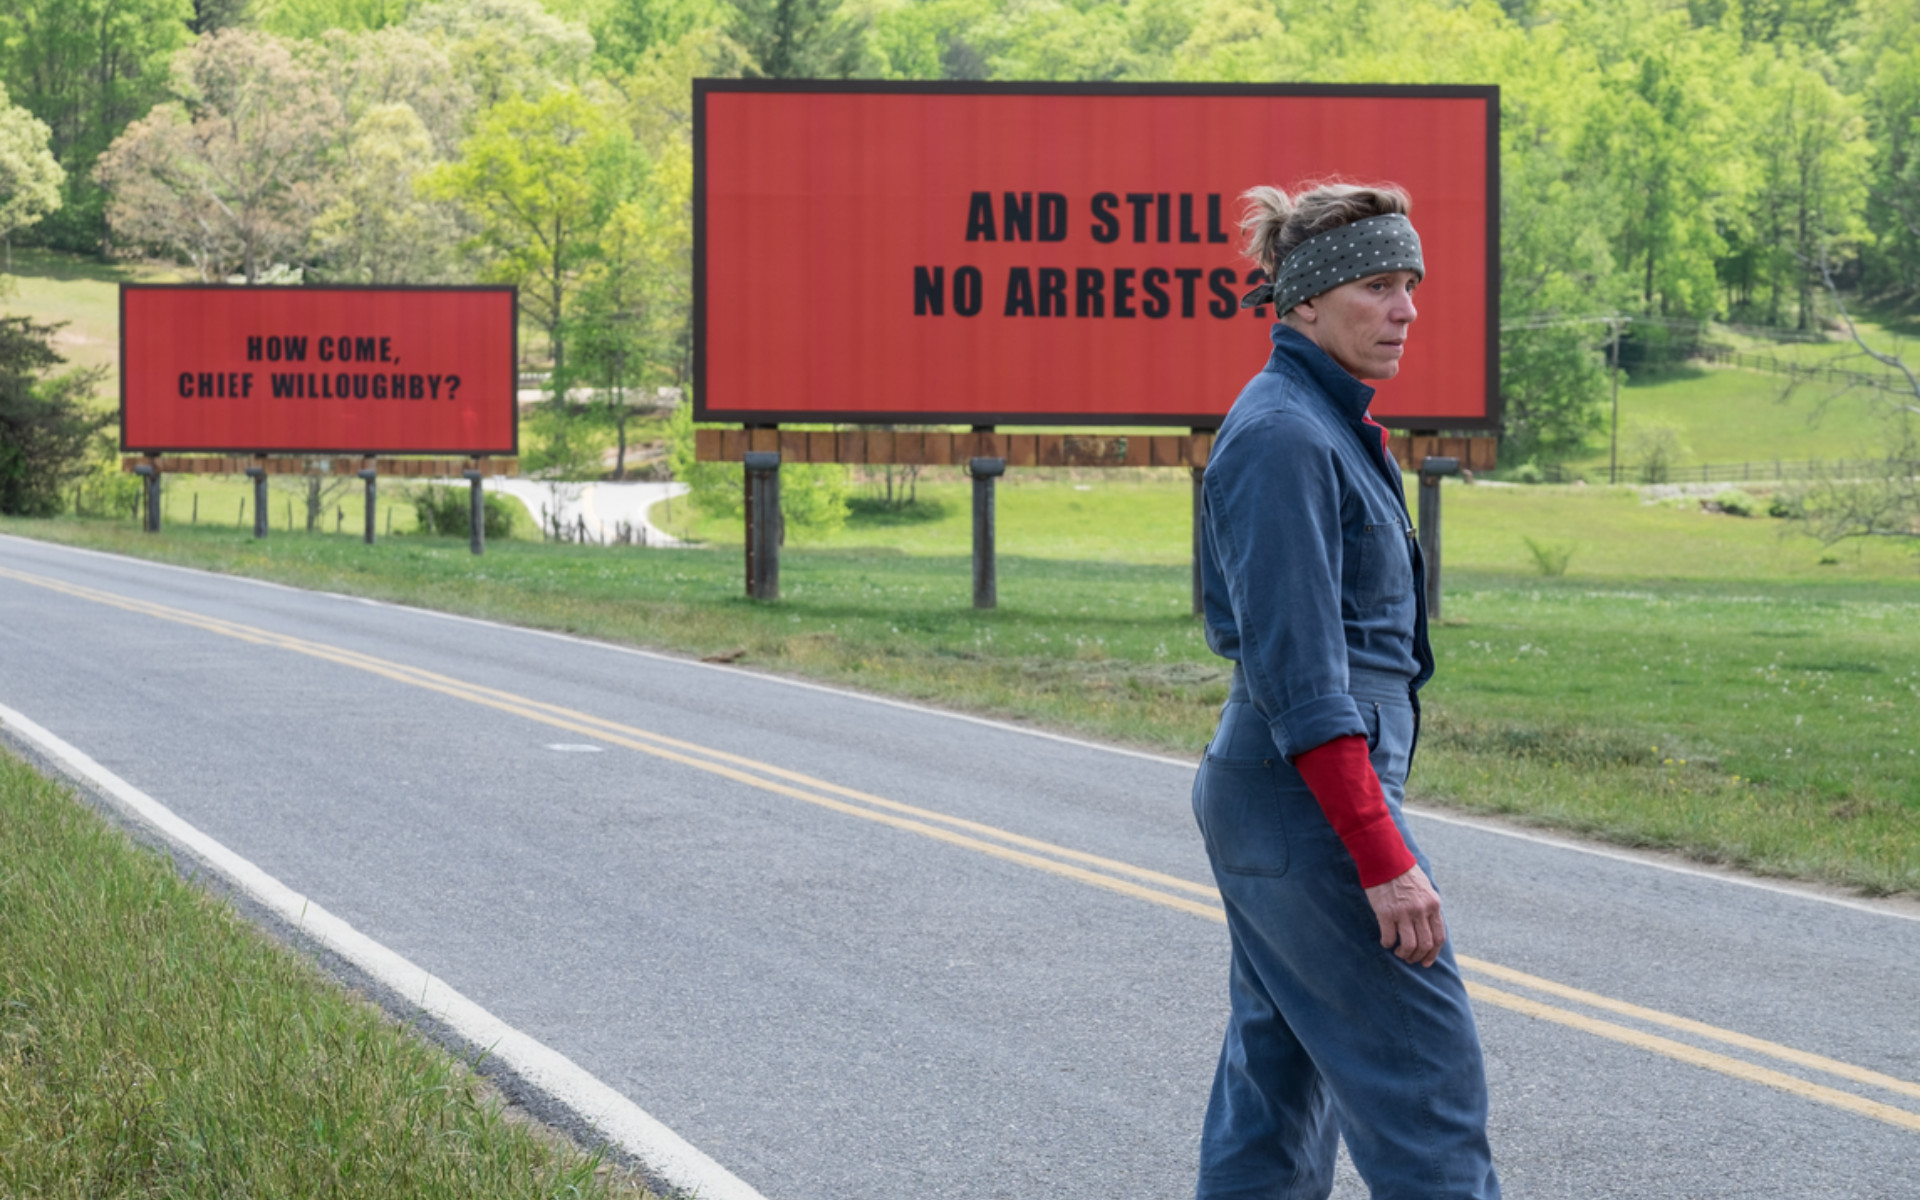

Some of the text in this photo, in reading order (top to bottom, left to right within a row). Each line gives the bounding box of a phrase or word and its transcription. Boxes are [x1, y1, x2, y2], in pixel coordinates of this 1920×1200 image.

[965, 191, 1230, 244] AND STILL
[913, 265, 984, 318] NO
[246, 335, 402, 366] HOW COME,
[178, 372, 462, 401] CHIEF WILLOUGHBY?
